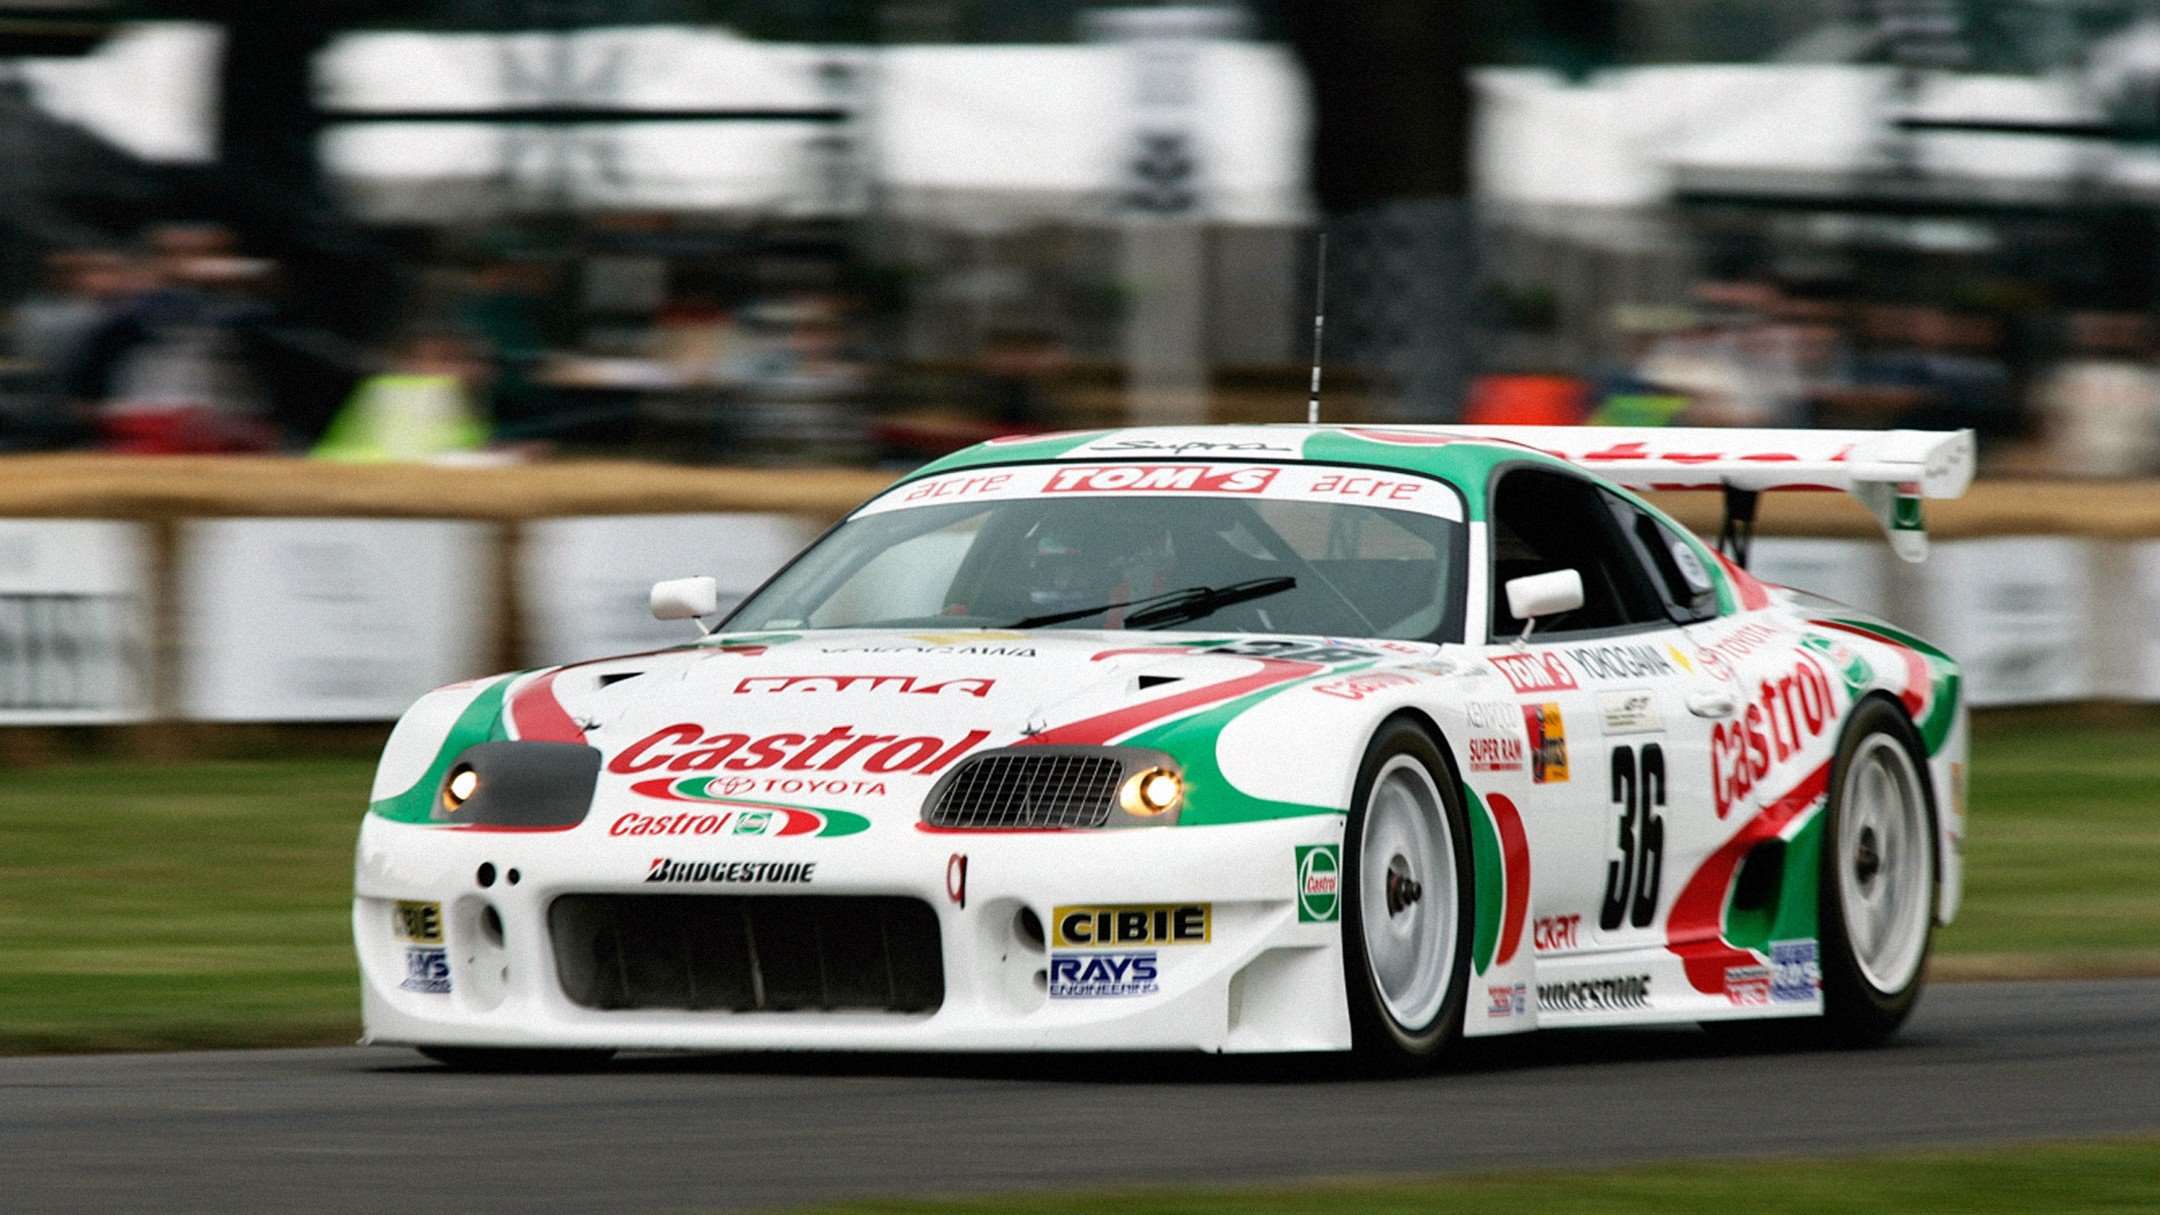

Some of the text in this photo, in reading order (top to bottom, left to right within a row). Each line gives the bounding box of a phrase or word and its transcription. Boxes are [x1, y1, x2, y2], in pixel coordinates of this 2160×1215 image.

[1089, 439, 1294, 455] Supra
[903, 473, 1013, 501] acre
[1052, 466, 1272, 491] TOM'S
[1310, 475, 1424, 499] acre
[1711, 647, 1836, 821] Castrol
[607, 723, 992, 775] Castrol
[763, 779, 887, 796] TOYOTA
[608, 812, 733, 837] Castrol
[1599, 742, 1666, 931] 36
[645, 858, 817, 883] BRIDGESTONE
[1051, 958, 1157, 982] RAYS
